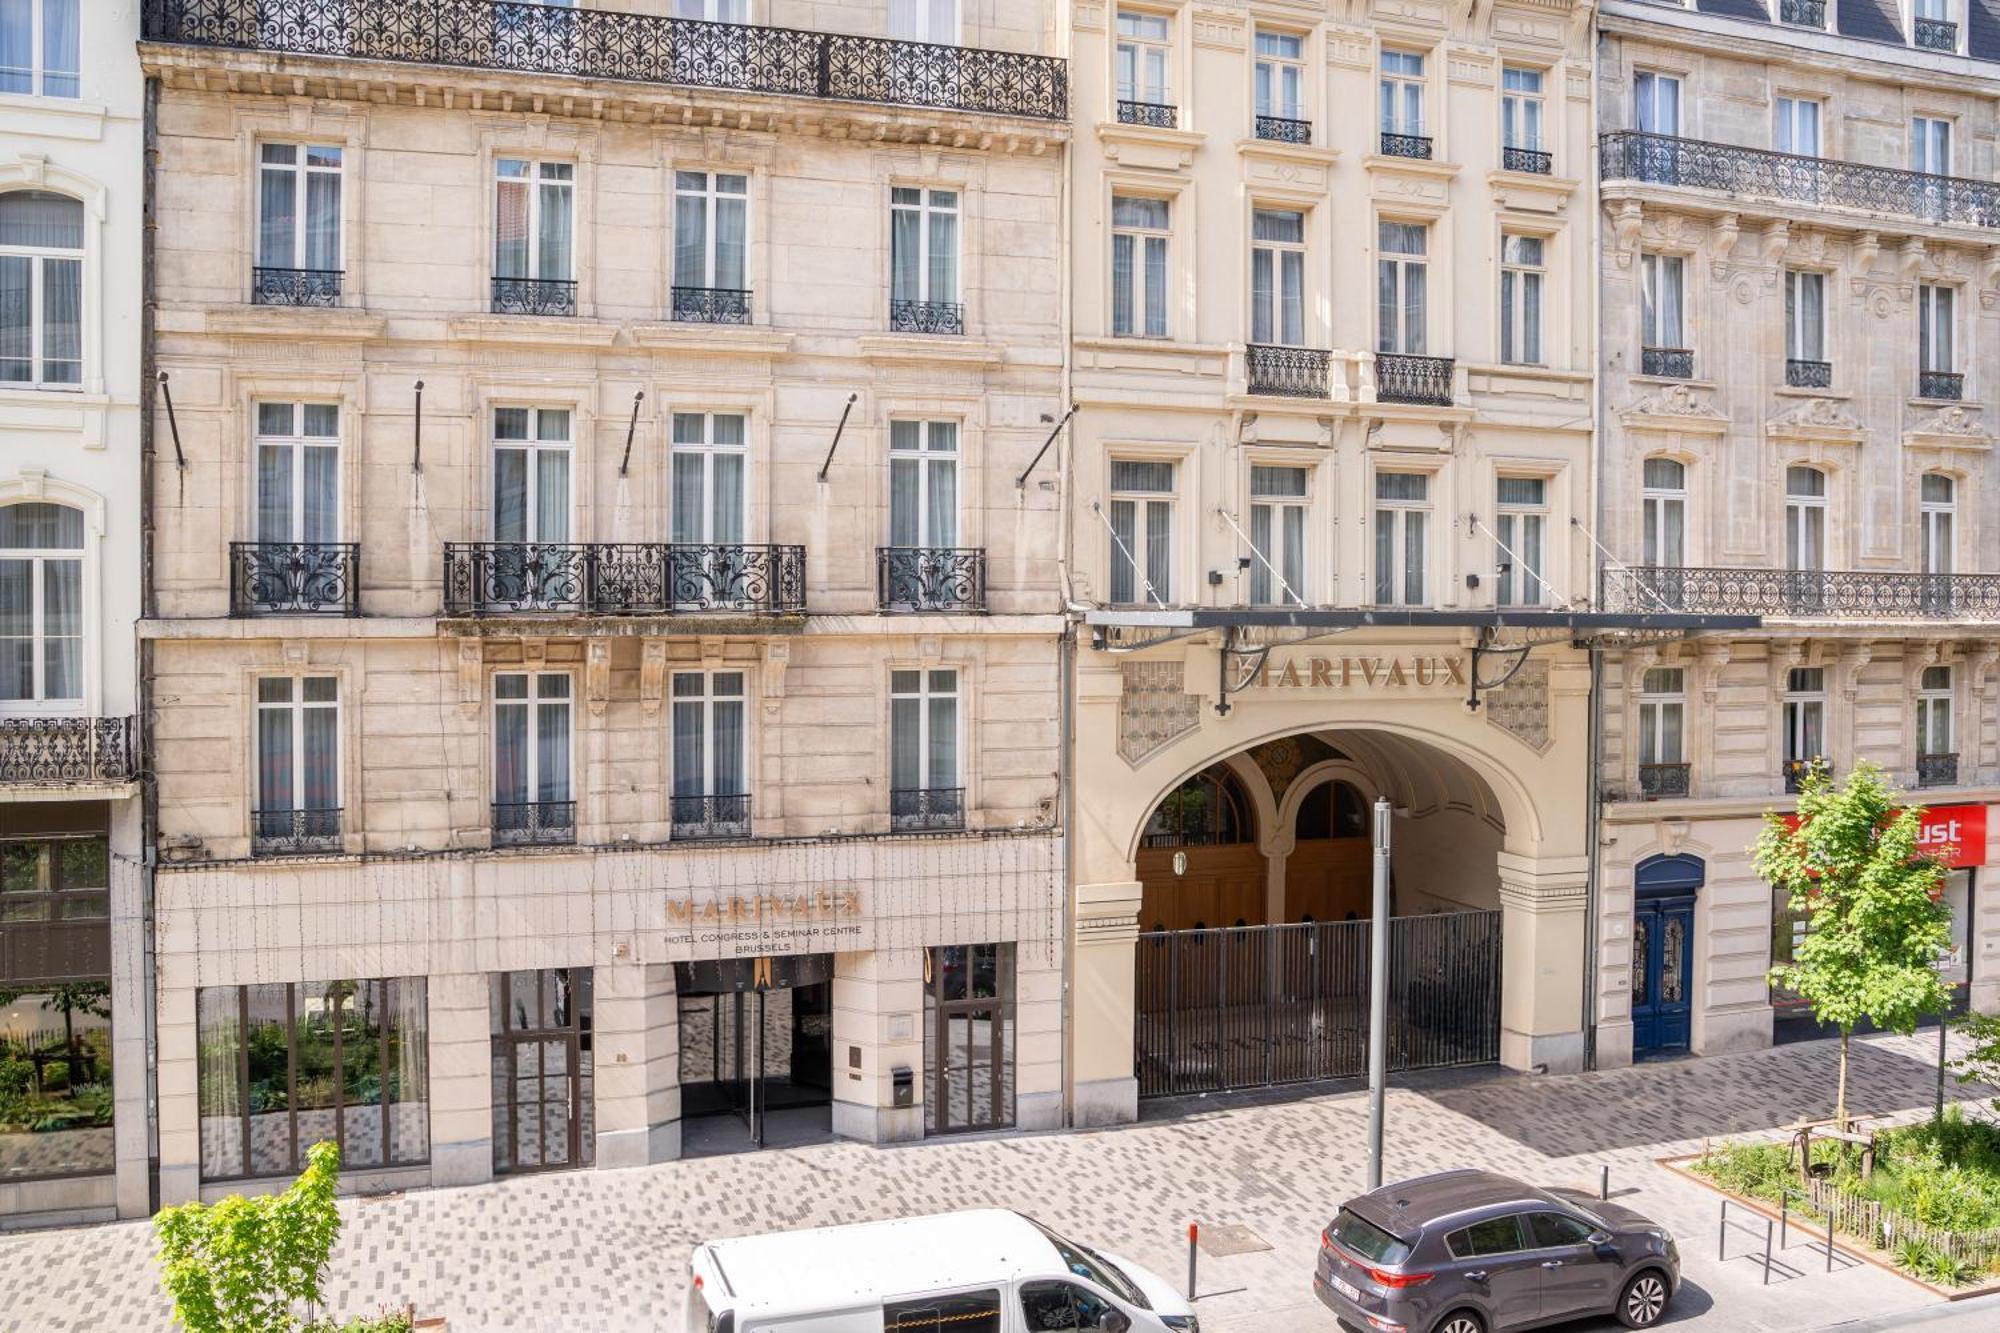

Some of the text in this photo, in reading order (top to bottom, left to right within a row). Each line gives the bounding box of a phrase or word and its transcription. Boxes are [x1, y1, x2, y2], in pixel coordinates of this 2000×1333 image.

[666, 890, 861, 921] MARIVAUX
[664, 925, 862, 945] HOTEL CONGRESS & SEMINAR CENTRE
[735, 943, 791, 955] BRUSSELS
